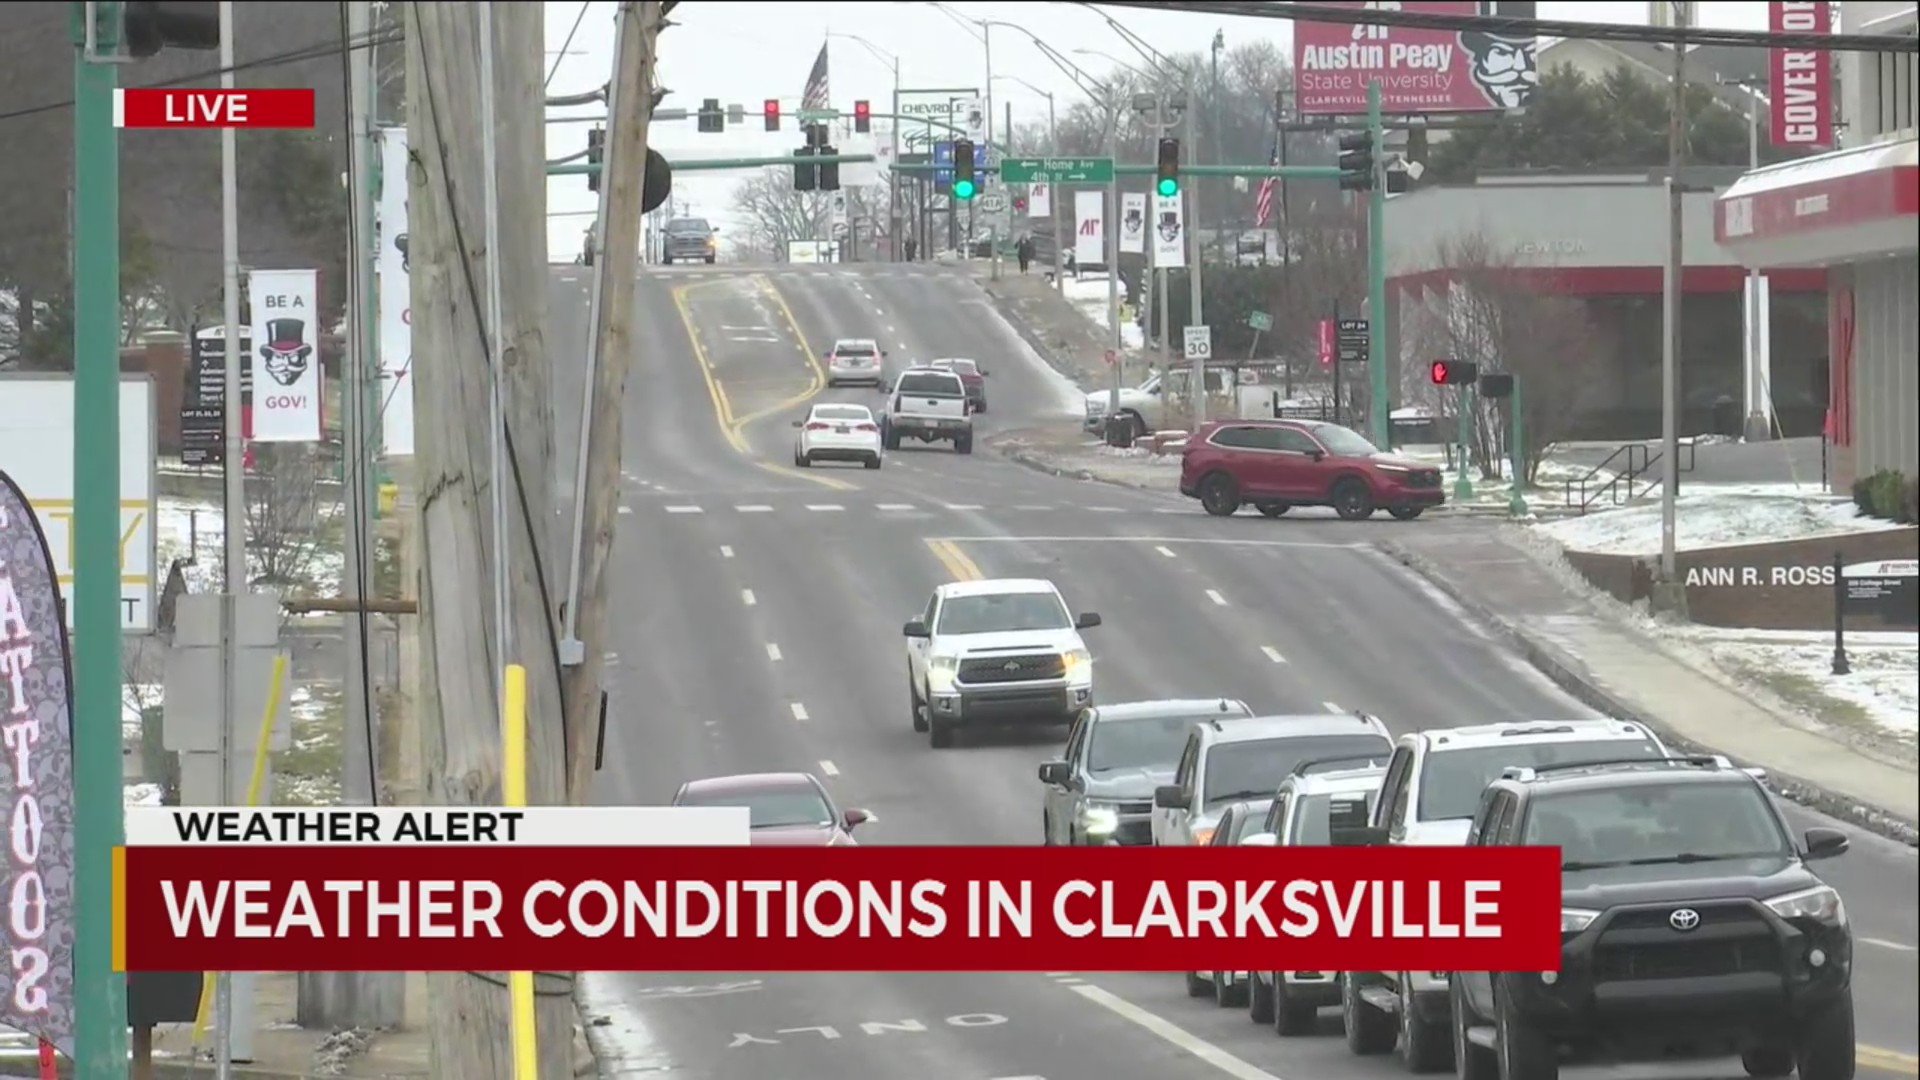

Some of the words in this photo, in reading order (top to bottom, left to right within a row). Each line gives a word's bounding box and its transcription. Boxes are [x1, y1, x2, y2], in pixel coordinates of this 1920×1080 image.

[1302, 42, 1384, 70] Austin
[1390, 43, 1453, 71] Peay
[1783, 1, 1818, 142] GOVERO
[1302, 73, 1352, 90] State
[1358, 71, 1453, 90] University
[1304, 96, 1368, 105] CLARKSVILL
[1390, 95, 1451, 104] TENNESSEE
[1043, 158, 1074, 170] Home
[1030, 171, 1049, 182] 4th
[266, 295, 286, 308] BE
[293, 295, 304, 308] A
[1187, 342, 1209, 356] 30
[266, 396, 307, 409] GOV!
[1685, 567, 1734, 587] ANN
[1742, 567, 1764, 586] R.
[1771, 565, 1836, 586] ROSS
[728, 1013, 1009, 1048] ONLY
